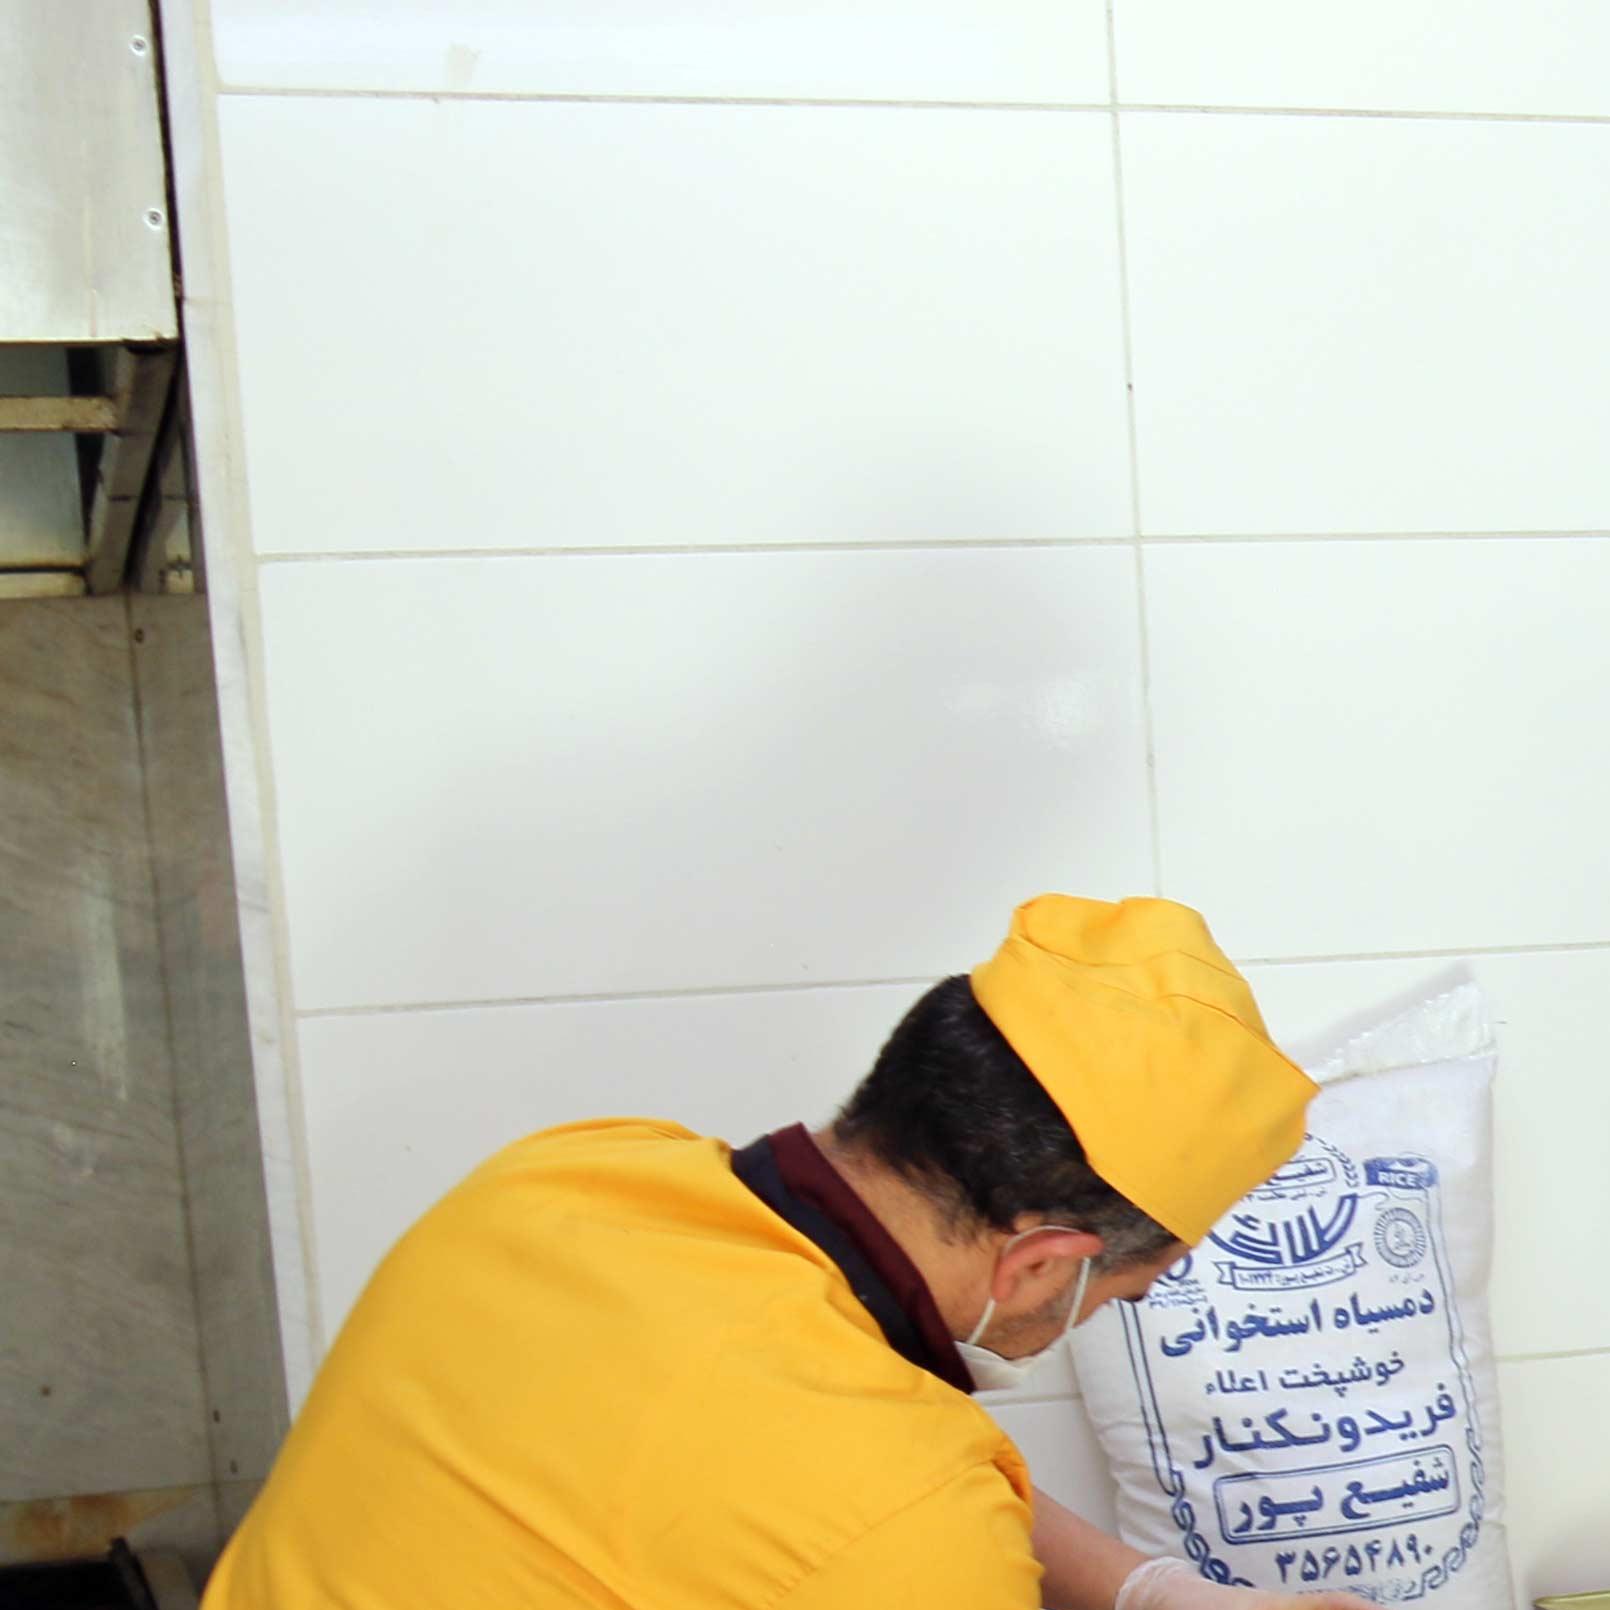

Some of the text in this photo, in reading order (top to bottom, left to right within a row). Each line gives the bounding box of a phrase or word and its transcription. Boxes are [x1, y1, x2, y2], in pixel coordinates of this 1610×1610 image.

[1377, 1170, 1417, 1188] RICE
[1160, 1288, 1435, 1357] دمسیاه استخوانی
[1278, 1350, 1405, 1398] خوشپخت
[1231, 1456, 1449, 1534] شفیع پور
